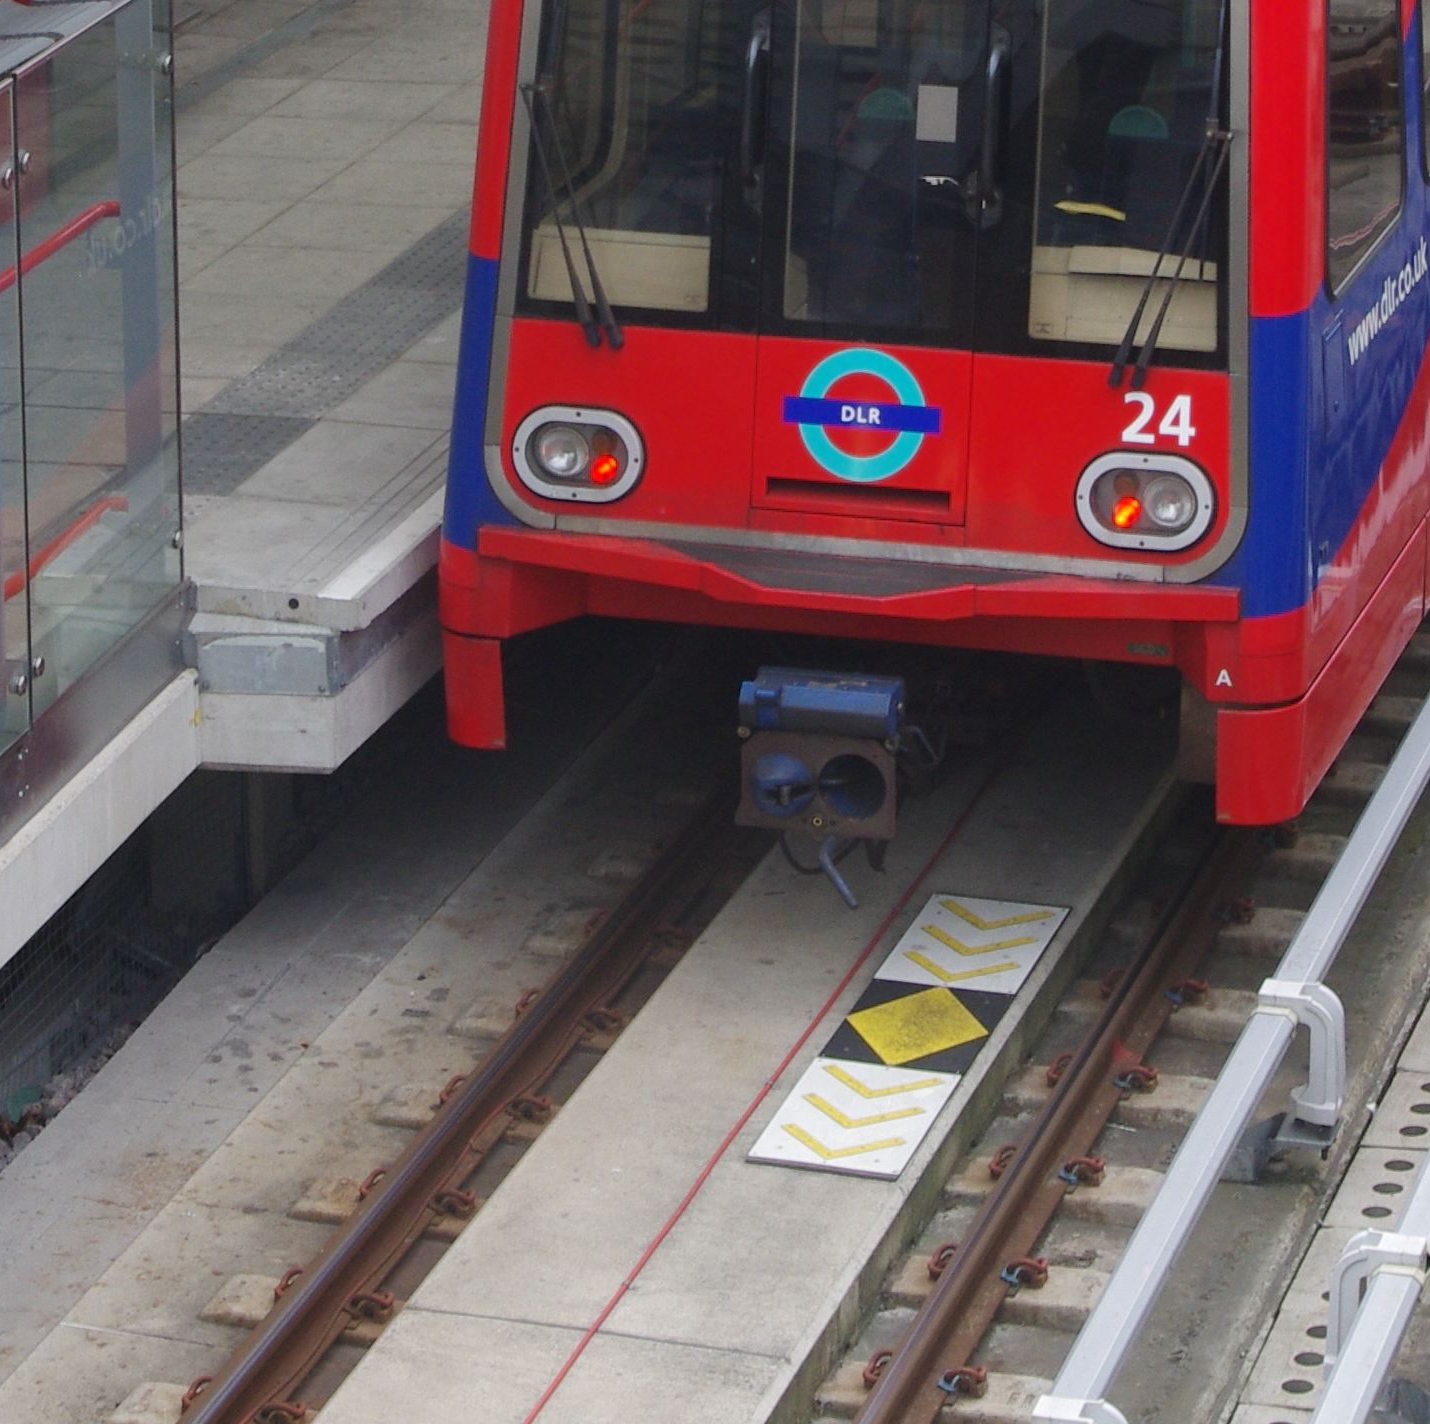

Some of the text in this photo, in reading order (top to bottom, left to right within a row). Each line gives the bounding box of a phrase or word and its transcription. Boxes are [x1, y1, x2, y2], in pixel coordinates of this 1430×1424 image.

[1347, 235, 1429, 366] www.dlr.co.uk
[840, 405, 881, 425] DLR
[1121, 390, 1197, 447] 24
[1215, 668, 1233, 688] A
